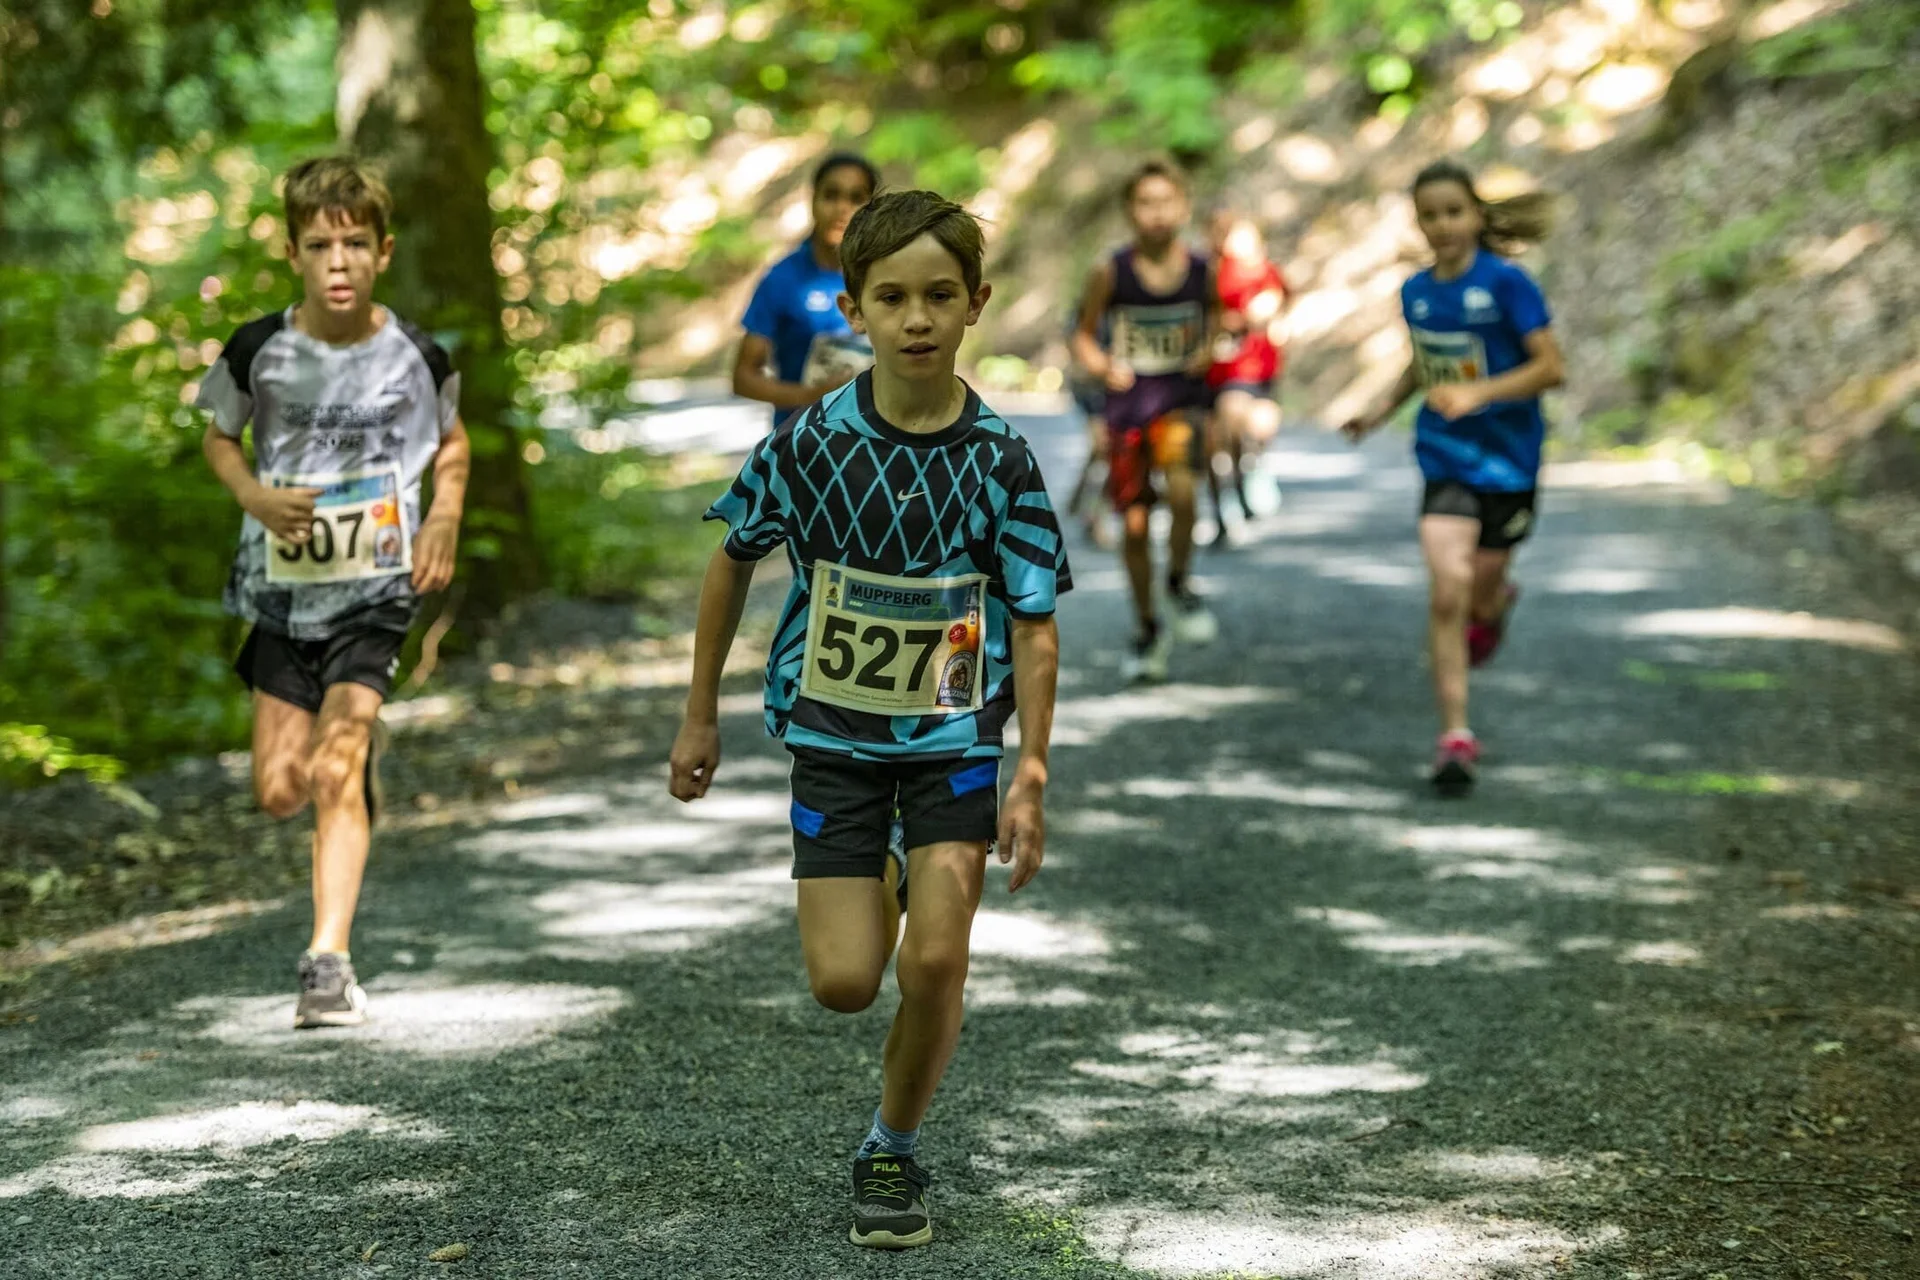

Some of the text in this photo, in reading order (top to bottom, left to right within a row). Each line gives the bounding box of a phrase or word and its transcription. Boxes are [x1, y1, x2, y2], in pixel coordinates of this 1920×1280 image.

[850, 584, 932, 606] MUPPBERG
[817, 615, 944, 692] 527
[873, 1163, 901, 1172] FILA
